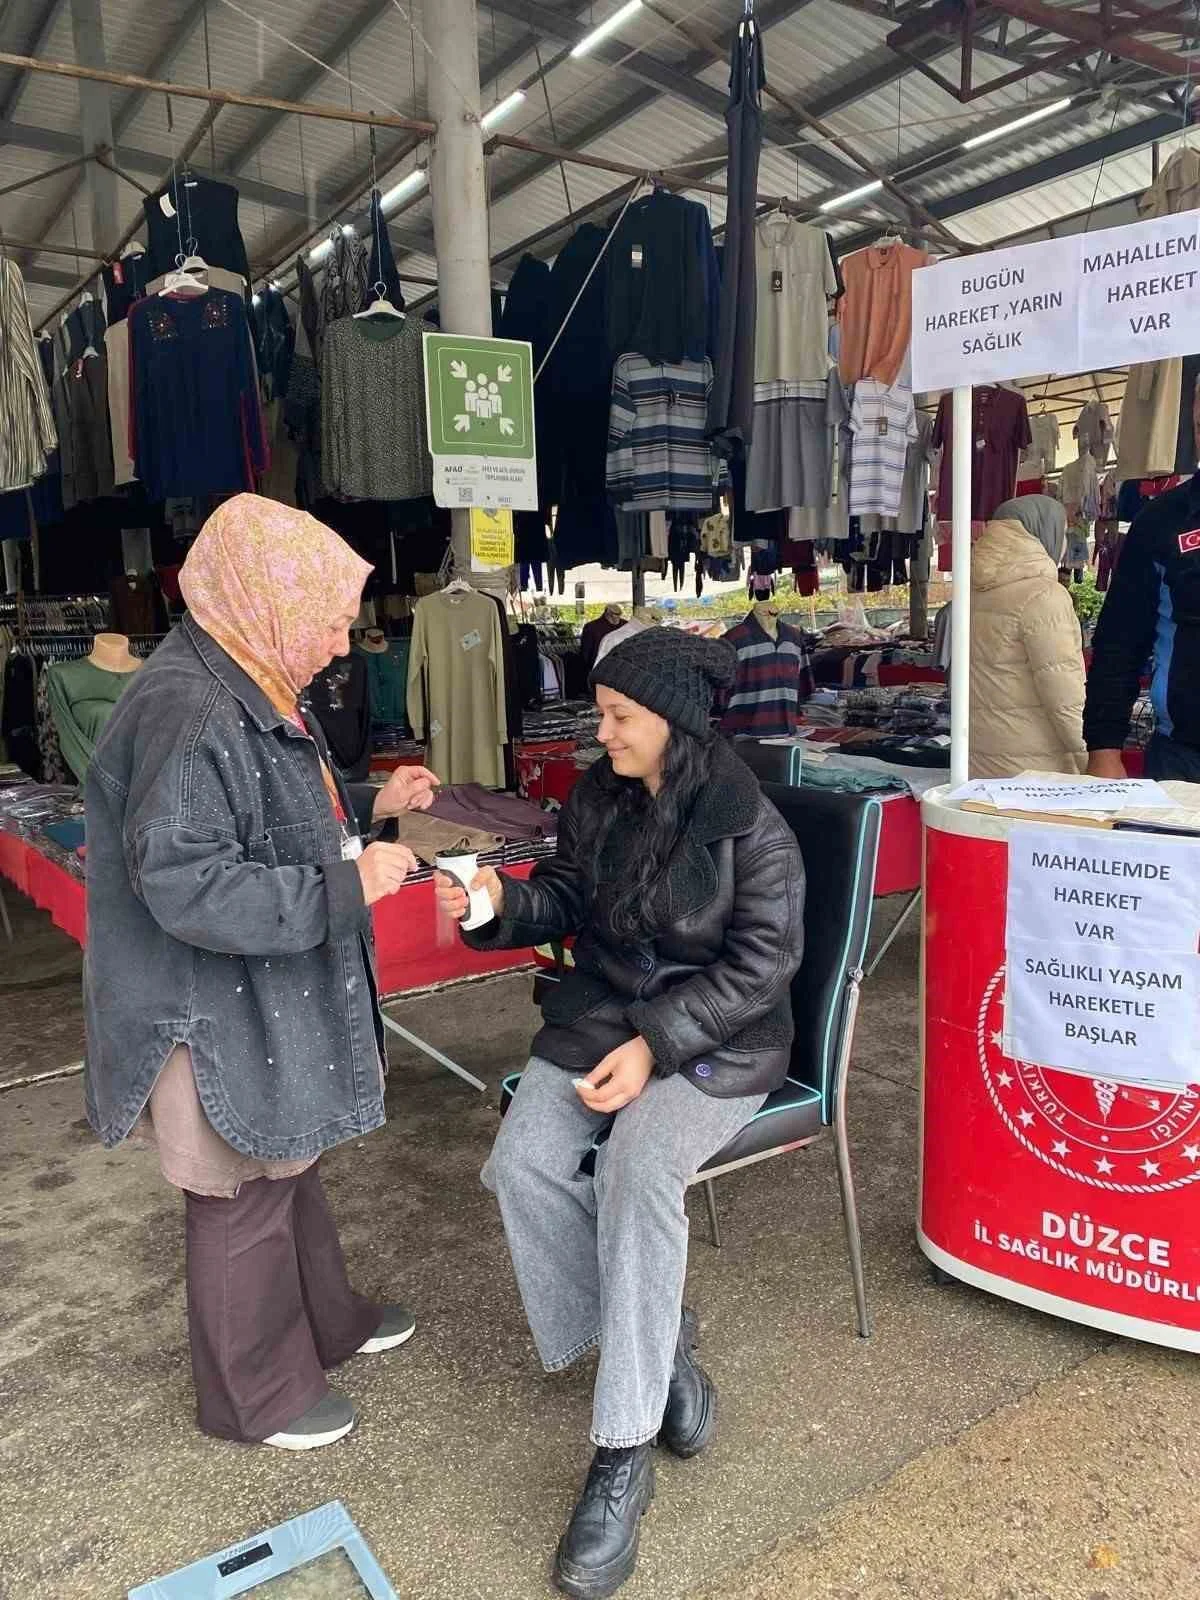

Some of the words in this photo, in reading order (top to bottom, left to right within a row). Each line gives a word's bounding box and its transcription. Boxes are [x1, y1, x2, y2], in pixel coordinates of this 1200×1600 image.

[961, 268, 1025, 295] BUGÜN
[1107, 270, 1198, 304] HAREKET
[926, 304, 999, 332] HAREKET
[1129, 312, 1171, 334] VAR
[962, 331, 1023, 355] SAĞLIK
[1031, 852, 1171, 881] MAHALLEMDE
[1054, 886, 1142, 911] HAREKET
[1075, 921, 1115, 940] VAR
[1025, 958, 1102, 983] SAĞLIKLI
[1109, 968, 1182, 991] YAŞAM
[1049, 991, 1155, 1018] HAREKETLE
[1065, 1022, 1137, 1047] BAŞLAR
[1150, 1081, 1200, 1141] ANLIĞI
[1042, 1211, 1170, 1268] DÜZCE
[975, 1219, 993, 1245] İL
[998, 1233, 1080, 1273] SAĞLIK
[1086, 1259, 1200, 1302] MÜDÜRL
